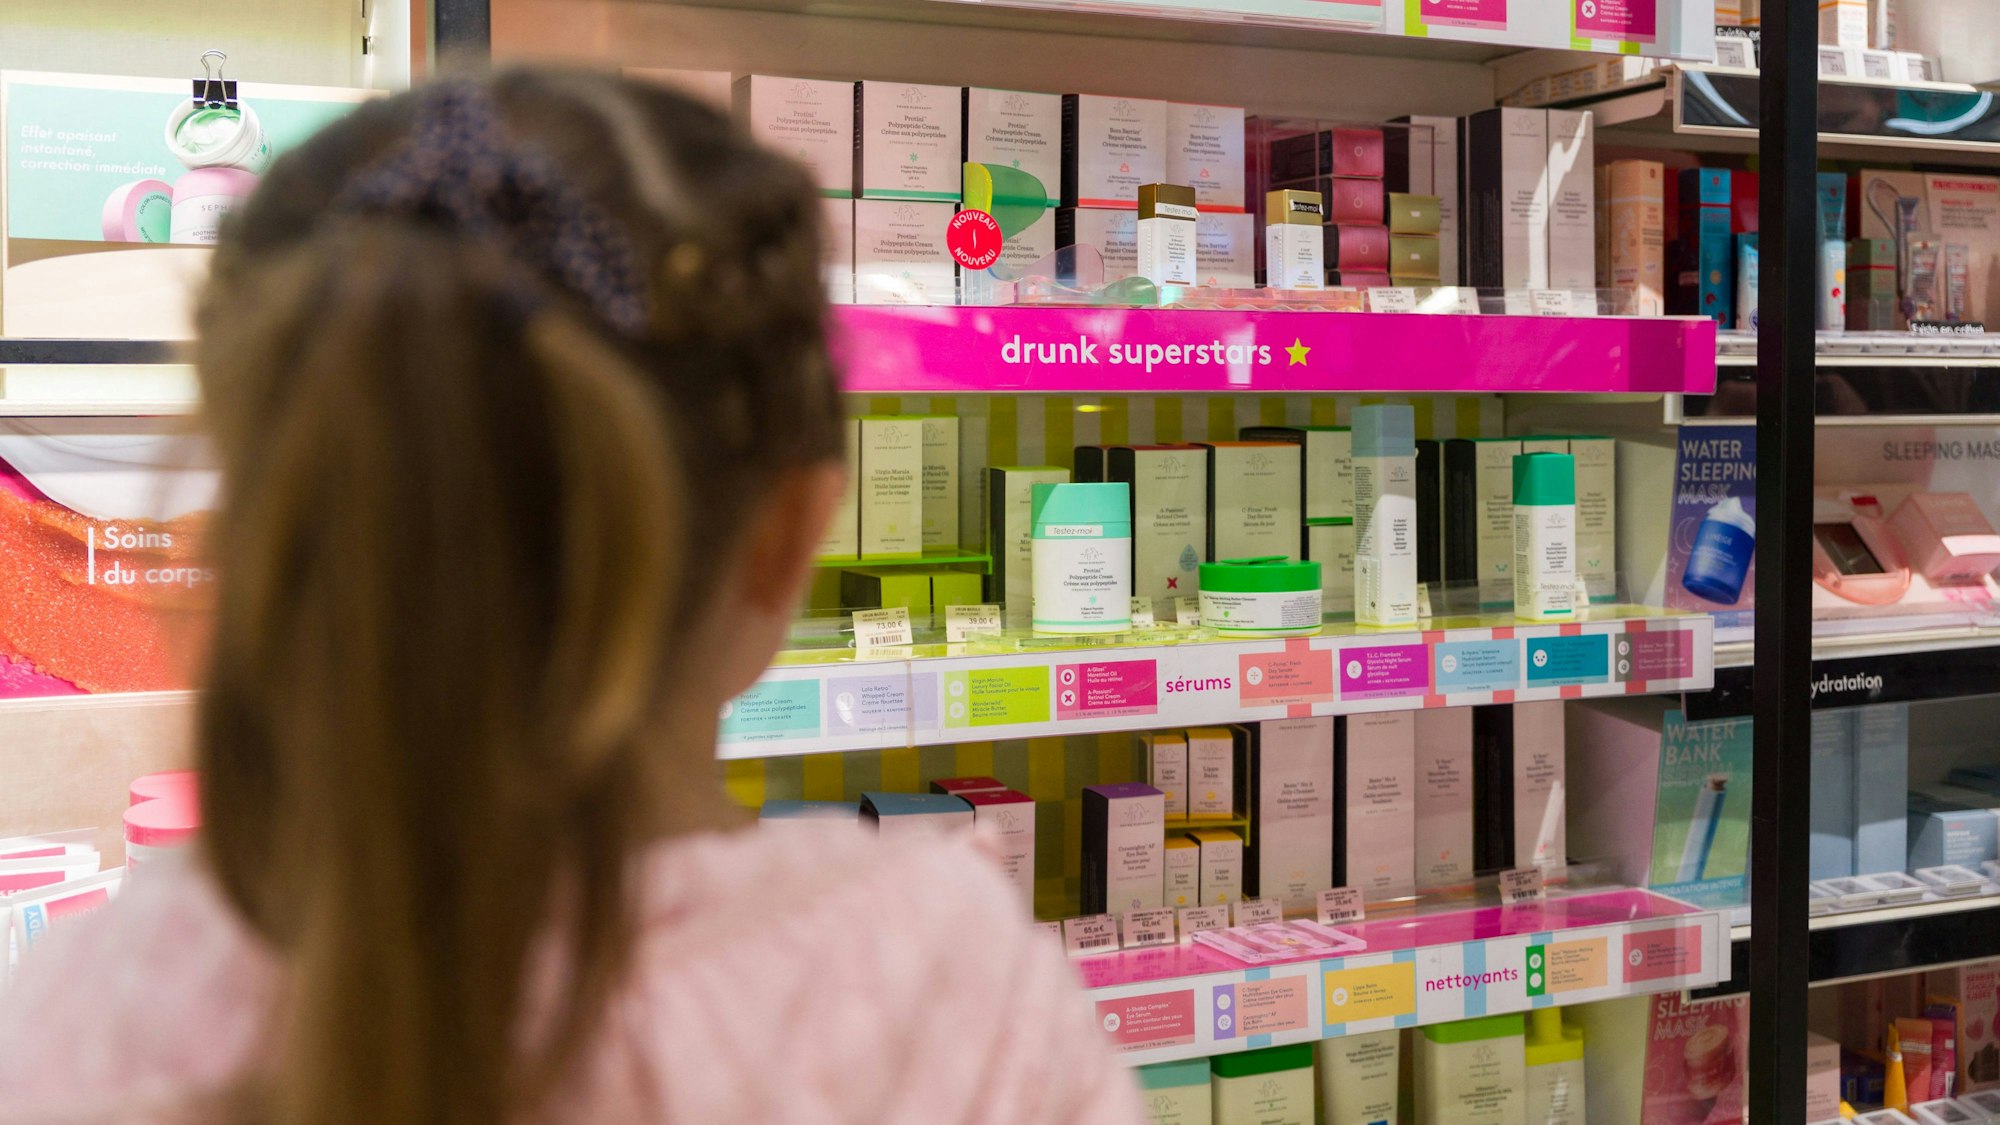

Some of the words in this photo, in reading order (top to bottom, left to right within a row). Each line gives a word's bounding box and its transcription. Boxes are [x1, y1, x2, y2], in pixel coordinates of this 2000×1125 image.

[20, 125, 52, 139] Effet
[57, 128, 117, 144] apaisant
[888, 122, 920, 130] Polypeptide
[20, 141, 96, 158] instantané,
[20, 158, 91, 172] correction
[95, 160, 166, 176] immédiate
[1293, 202, 1319, 214] estez-moi
[952, 211, 996, 231] NOUVEAU
[954, 246, 996, 266] NOUVEAU
[1001, 335, 1098, 364] drunk
[1109, 339, 1272, 372] superstars
[1682, 440, 1742, 460] WATER
[1882, 440, 1962, 461] SLEEPING
[1681, 462, 1757, 482] SLEEPIN
[1678, 483, 1731, 504] MASK
[104, 526, 172, 549] Soins
[1054, 526, 1093, 536] Testez-moi
[104, 560, 136, 585] du
[145, 567, 214, 588] corps
[1166, 676, 1232, 693] sérums
[1811, 672, 1883, 699] ydratation
[771, 705, 806, 713] polypeptides
[1666, 720, 1736, 744] WATER
[1666, 742, 1722, 766] BANK
[1426, 968, 1518, 992] nettoyants
[1654, 1014, 1710, 1040] MASK
